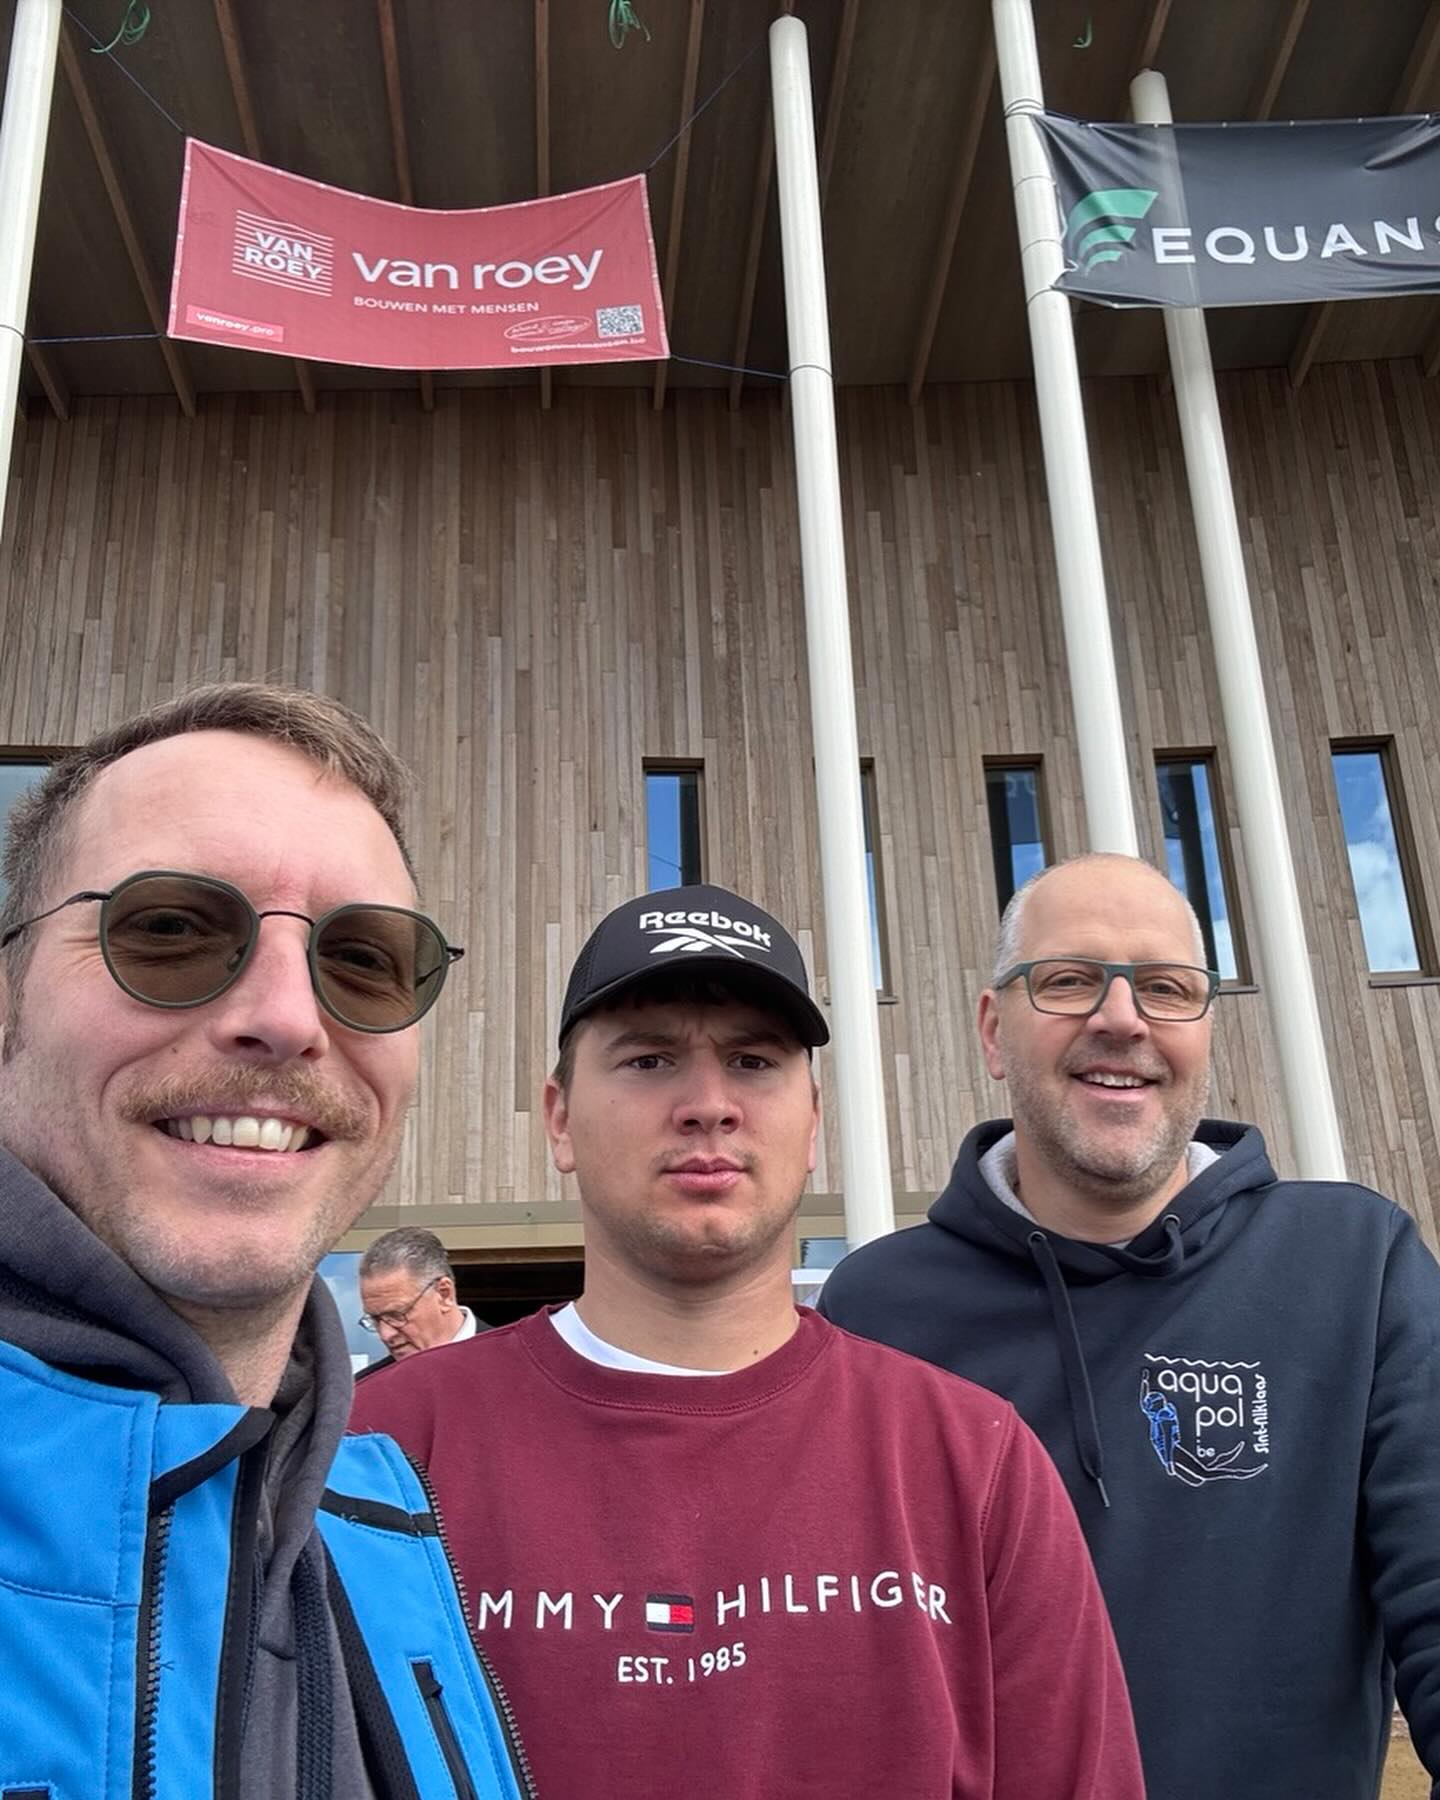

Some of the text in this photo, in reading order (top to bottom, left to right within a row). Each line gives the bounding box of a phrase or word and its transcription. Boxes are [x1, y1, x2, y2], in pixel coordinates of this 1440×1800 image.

[255, 231, 314, 262] VAN
[1151, 215, 1440, 265] EQUAN
[244, 246, 323, 280] ROEY
[351, 249, 603, 291] van roey
[353, 296, 540, 315] BOUWEN MET MENSEN
[638, 910, 772, 948] Reebok
[1157, 1369, 1244, 1404] aqua
[1195, 1397, 1244, 1438] pol
[477, 1570, 953, 1631] MMY HILFIGER
[617, 1641, 747, 1685] EST. 1985
